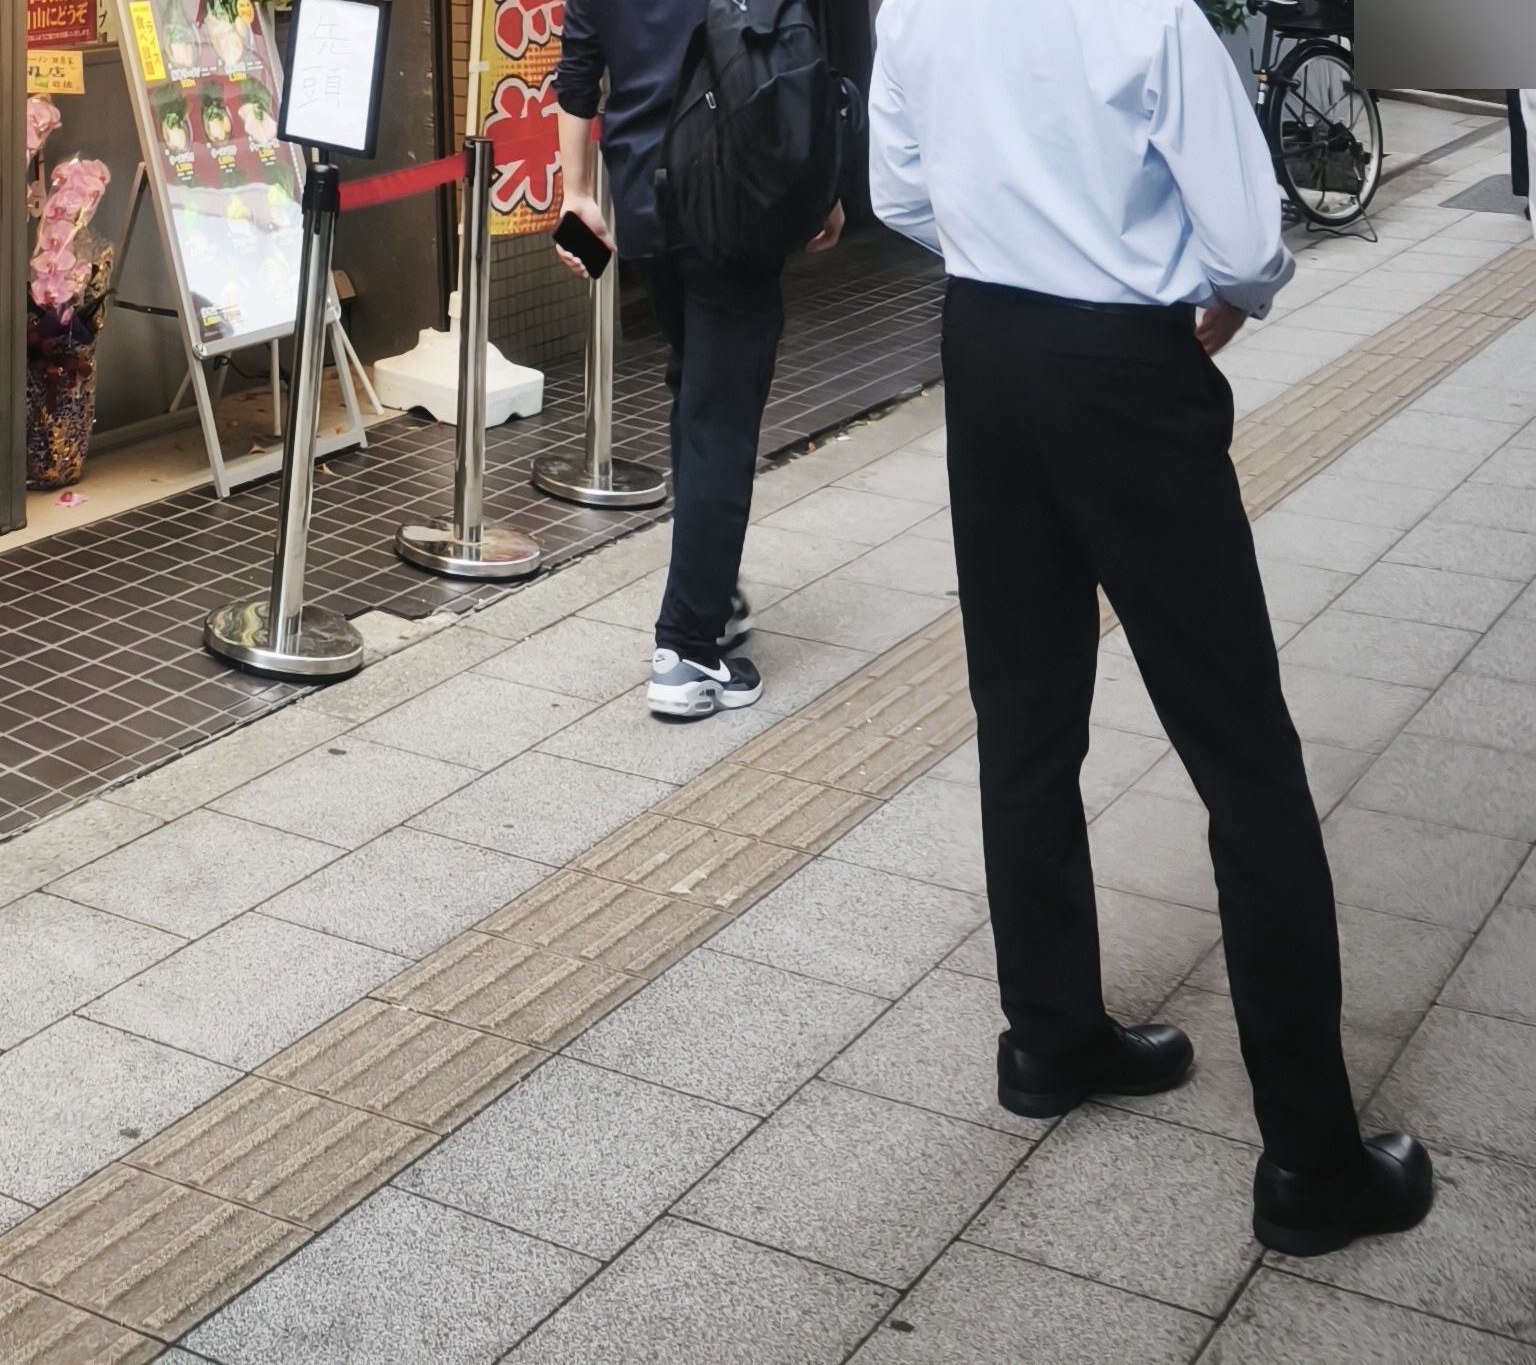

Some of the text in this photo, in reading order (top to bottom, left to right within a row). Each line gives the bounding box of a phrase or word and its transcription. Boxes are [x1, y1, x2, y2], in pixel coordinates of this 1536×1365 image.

[27, 2, 88, 31] 由にどうぞ
[298, 13, 352, 109] 先頭
